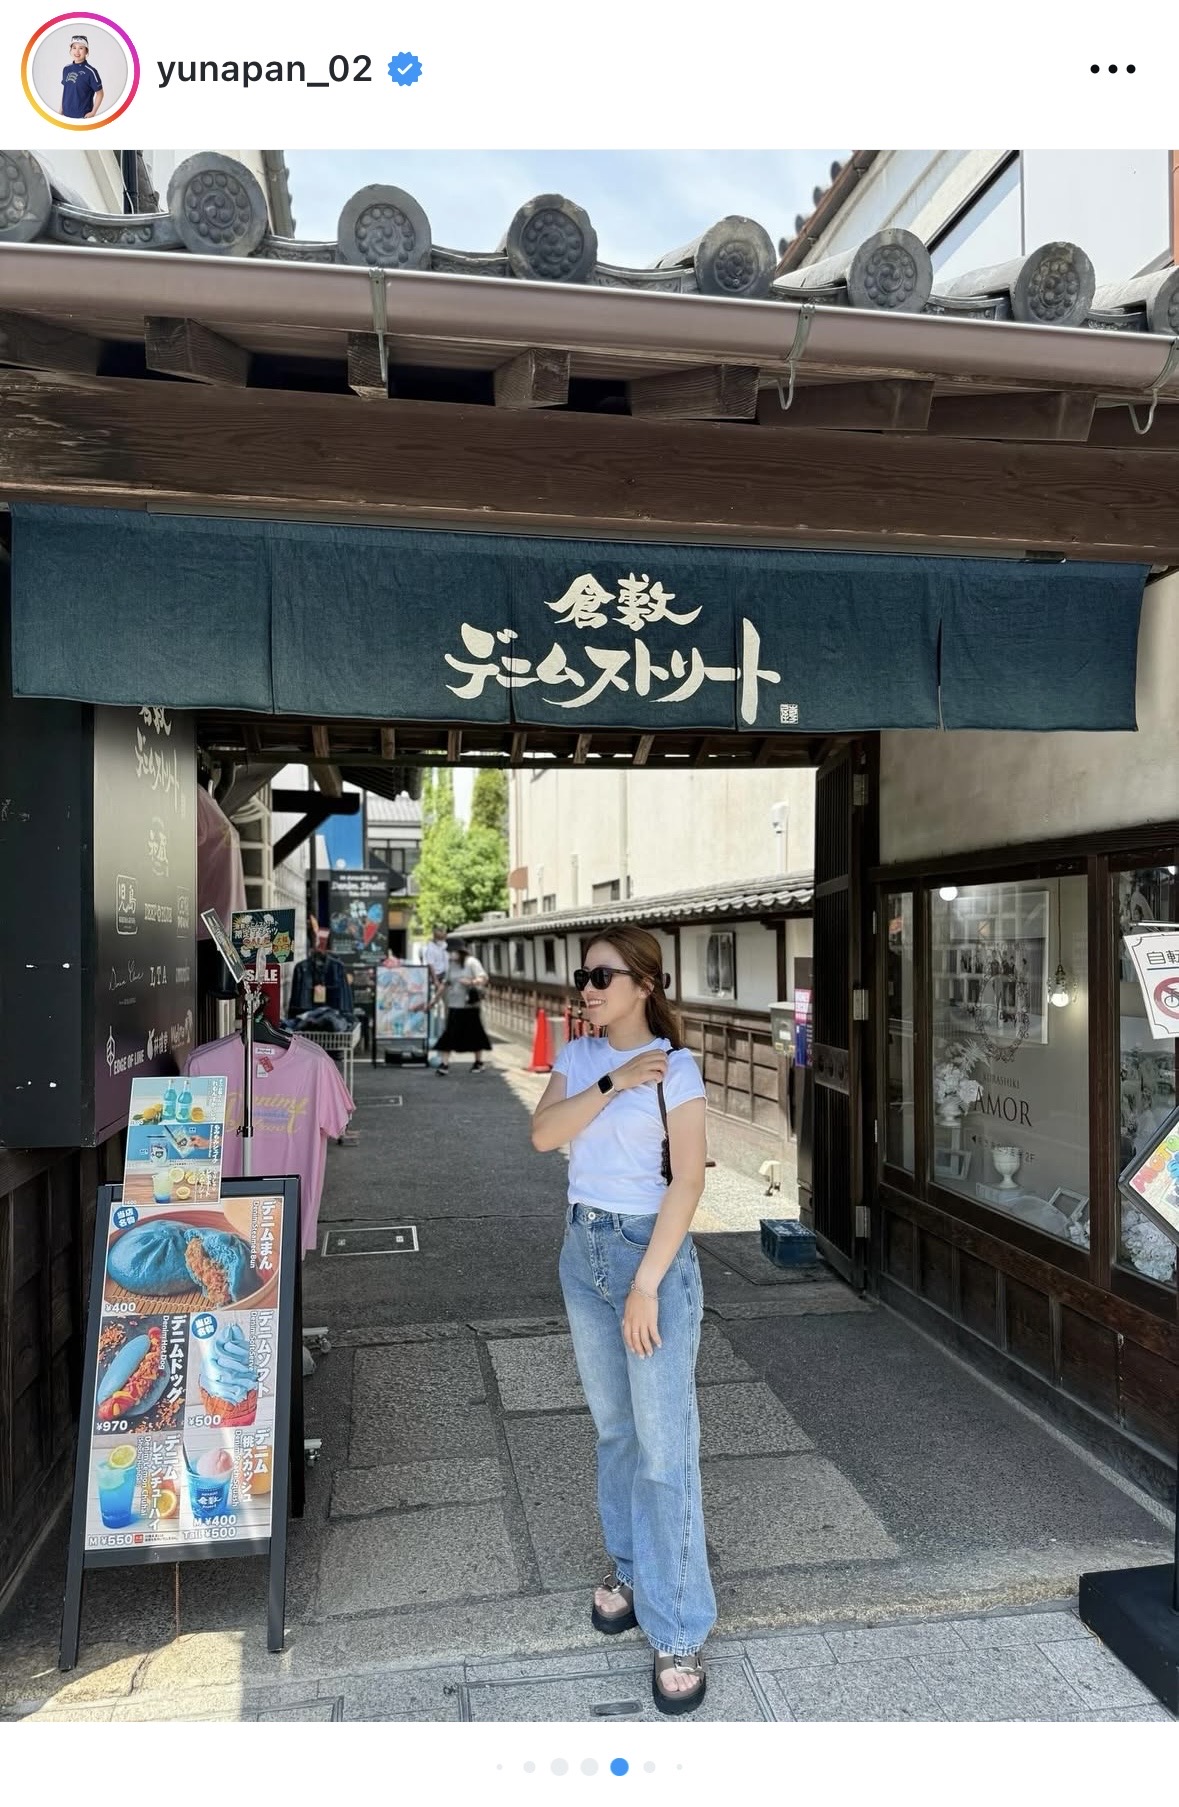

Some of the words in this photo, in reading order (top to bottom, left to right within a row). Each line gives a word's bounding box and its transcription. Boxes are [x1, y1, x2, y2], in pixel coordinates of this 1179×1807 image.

[544, 573, 703, 631] 倉敷
[445, 618, 781, 725] デニムストリート
[244, 969, 278, 981] SLE
[974, 1085, 1033, 1127] AMOR
[259, 1201, 276, 1270] デニムまん
[105, 1303, 136, 1313] ¥400
[160, 1315, 169, 1339] Denim
[167, 1314, 187, 1402] デニムドッグ
[257, 1310, 274, 1397] デニムソフト
[96, 1420, 128, 1431] ¥970
[188, 1415, 222, 1426] ¥500
[163, 1434, 181, 1480] デニム
[241, 1435, 255, 1502] 桃スカッシュ
[253, 1428, 272, 1473] デニム
[149, 1441, 163, 1531] レモンチューハイ
[101, 1535, 132, 1545] ¥550
[205, 1515, 236, 1526] ¥400
[205, 1527, 236, 1538] ¥500
